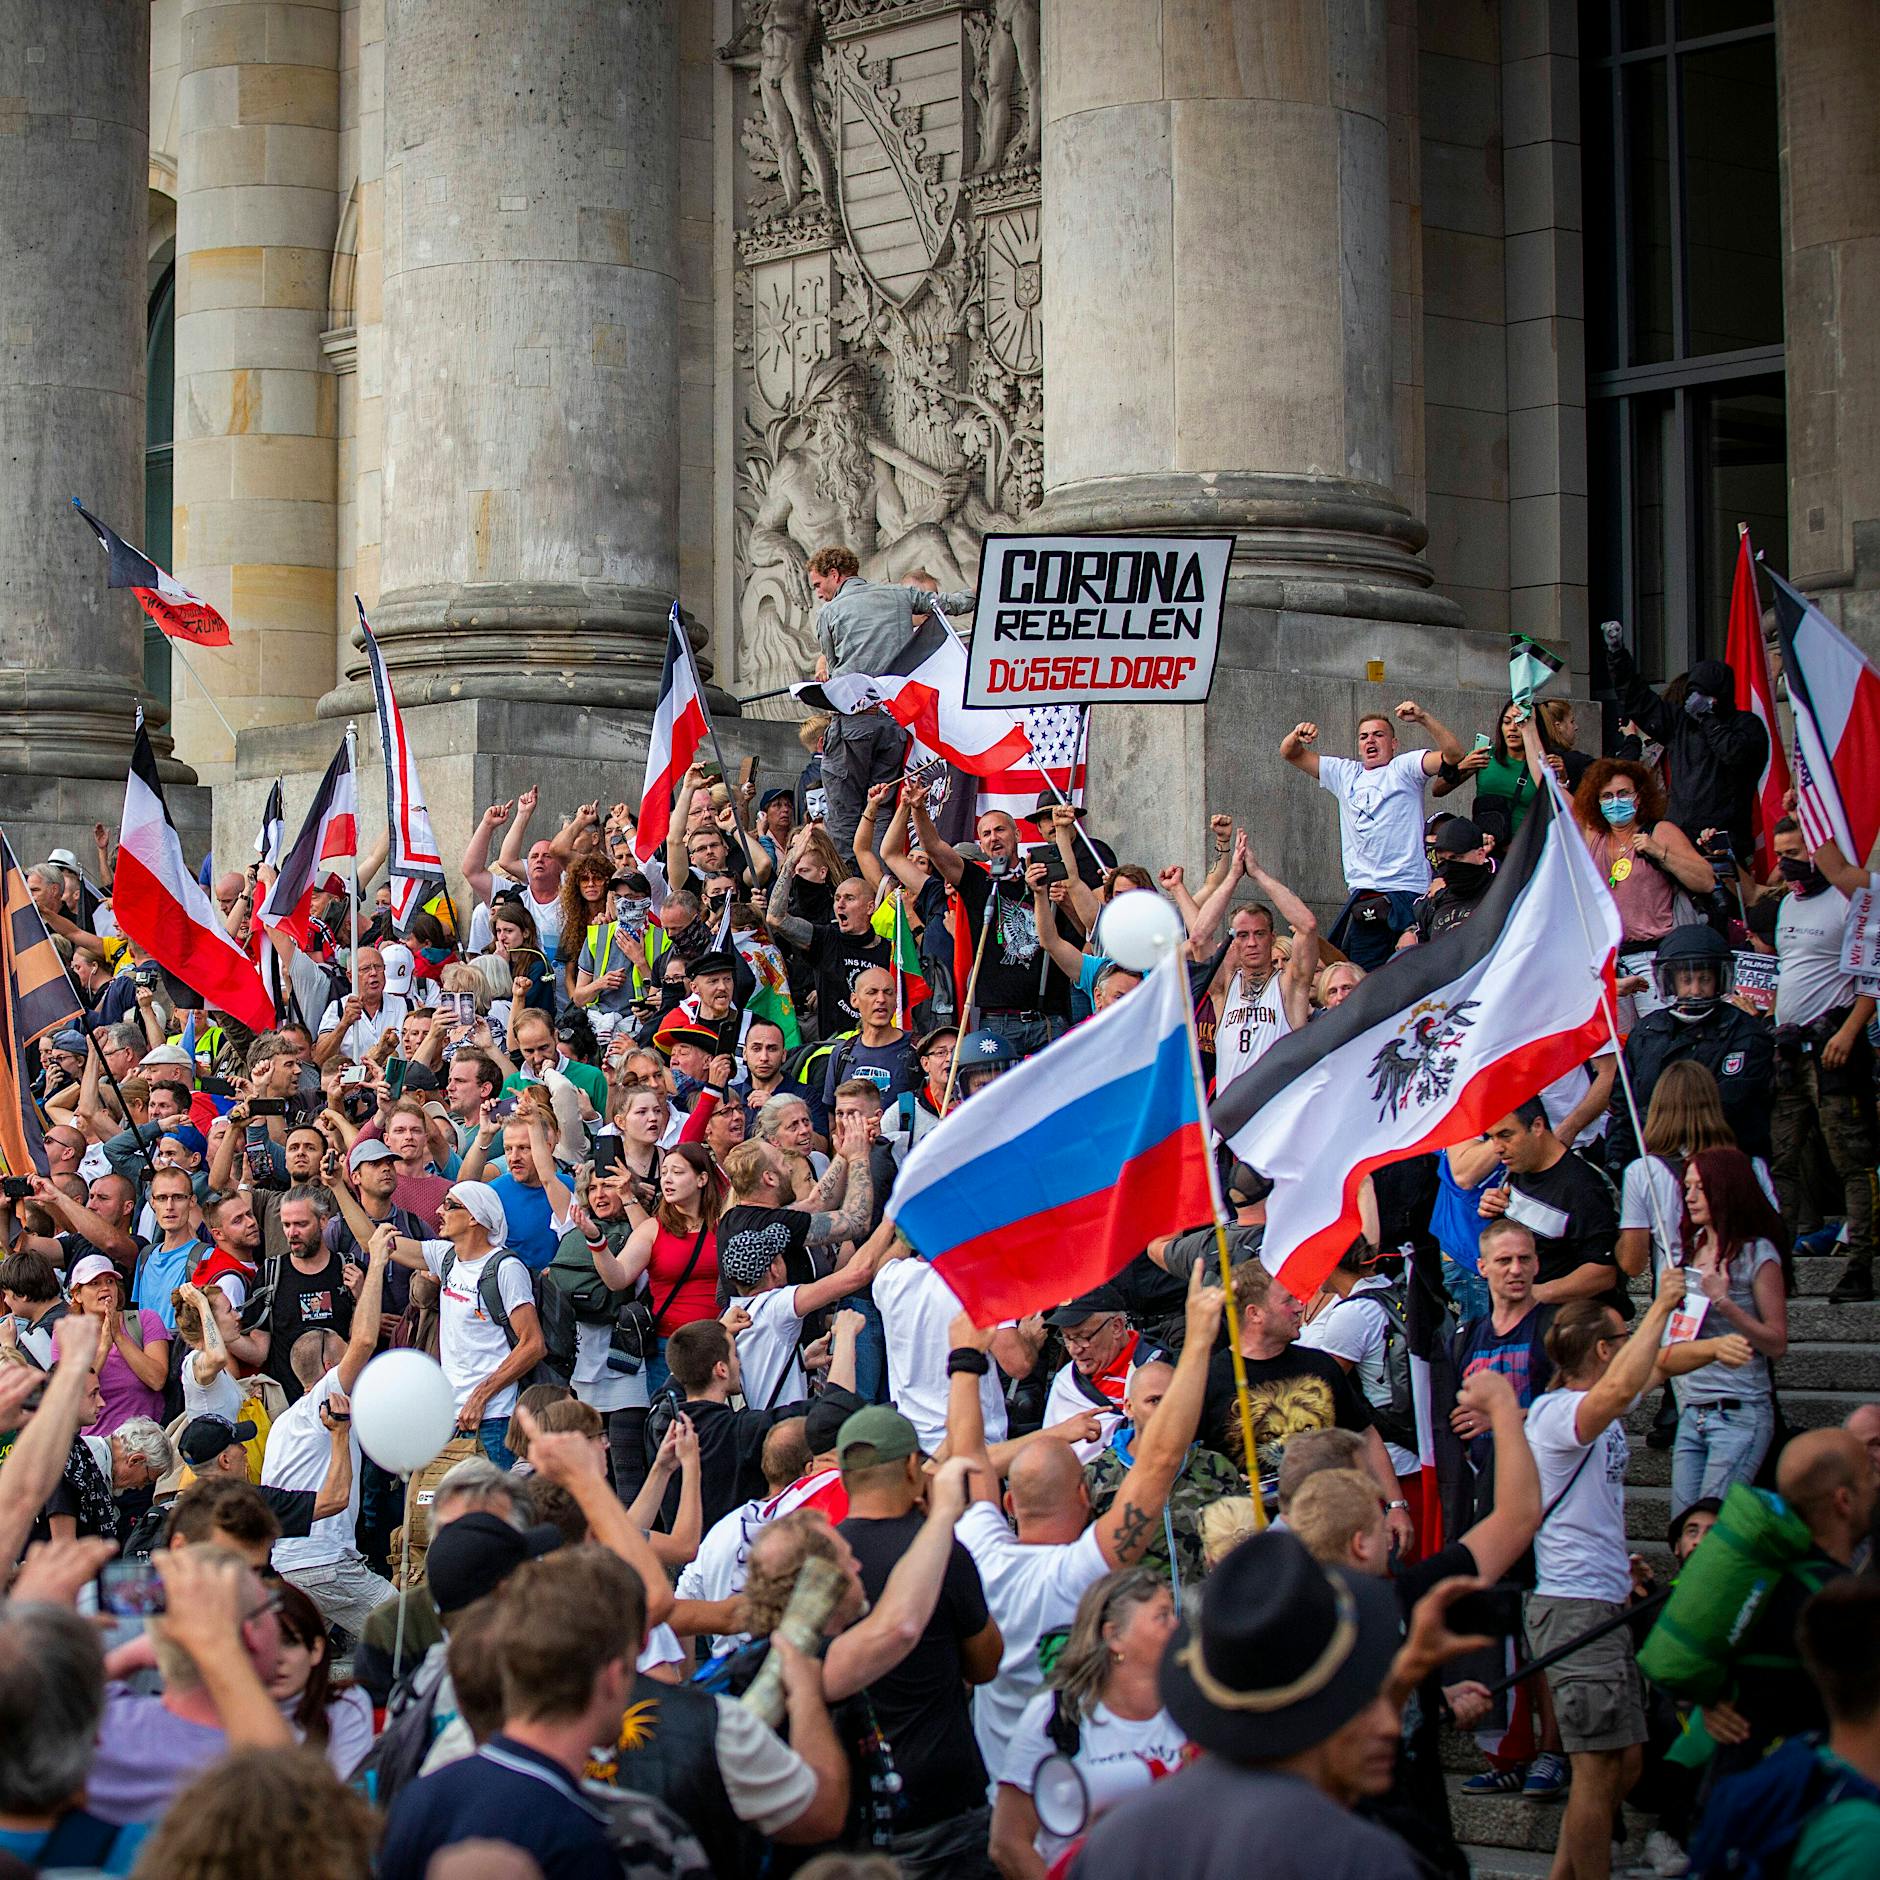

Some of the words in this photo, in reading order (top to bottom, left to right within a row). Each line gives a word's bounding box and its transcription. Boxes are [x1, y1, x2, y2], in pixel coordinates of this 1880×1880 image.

[999, 549, 1205, 604] CORONA
[183, 616, 223, 634] TRUMP
[994, 607, 1202, 641] REBELLEN
[986, 656, 1196, 693] DÜSSELDORF
[1860, 892, 1872, 913] der
[1856, 915, 1868, 940] sind
[1849, 944, 1862, 966] Wir
[397, 964, 406, 977] Q
[1225, 1006, 1276, 1028] COMPTON
[1239, 1029, 1251, 1053] 8
